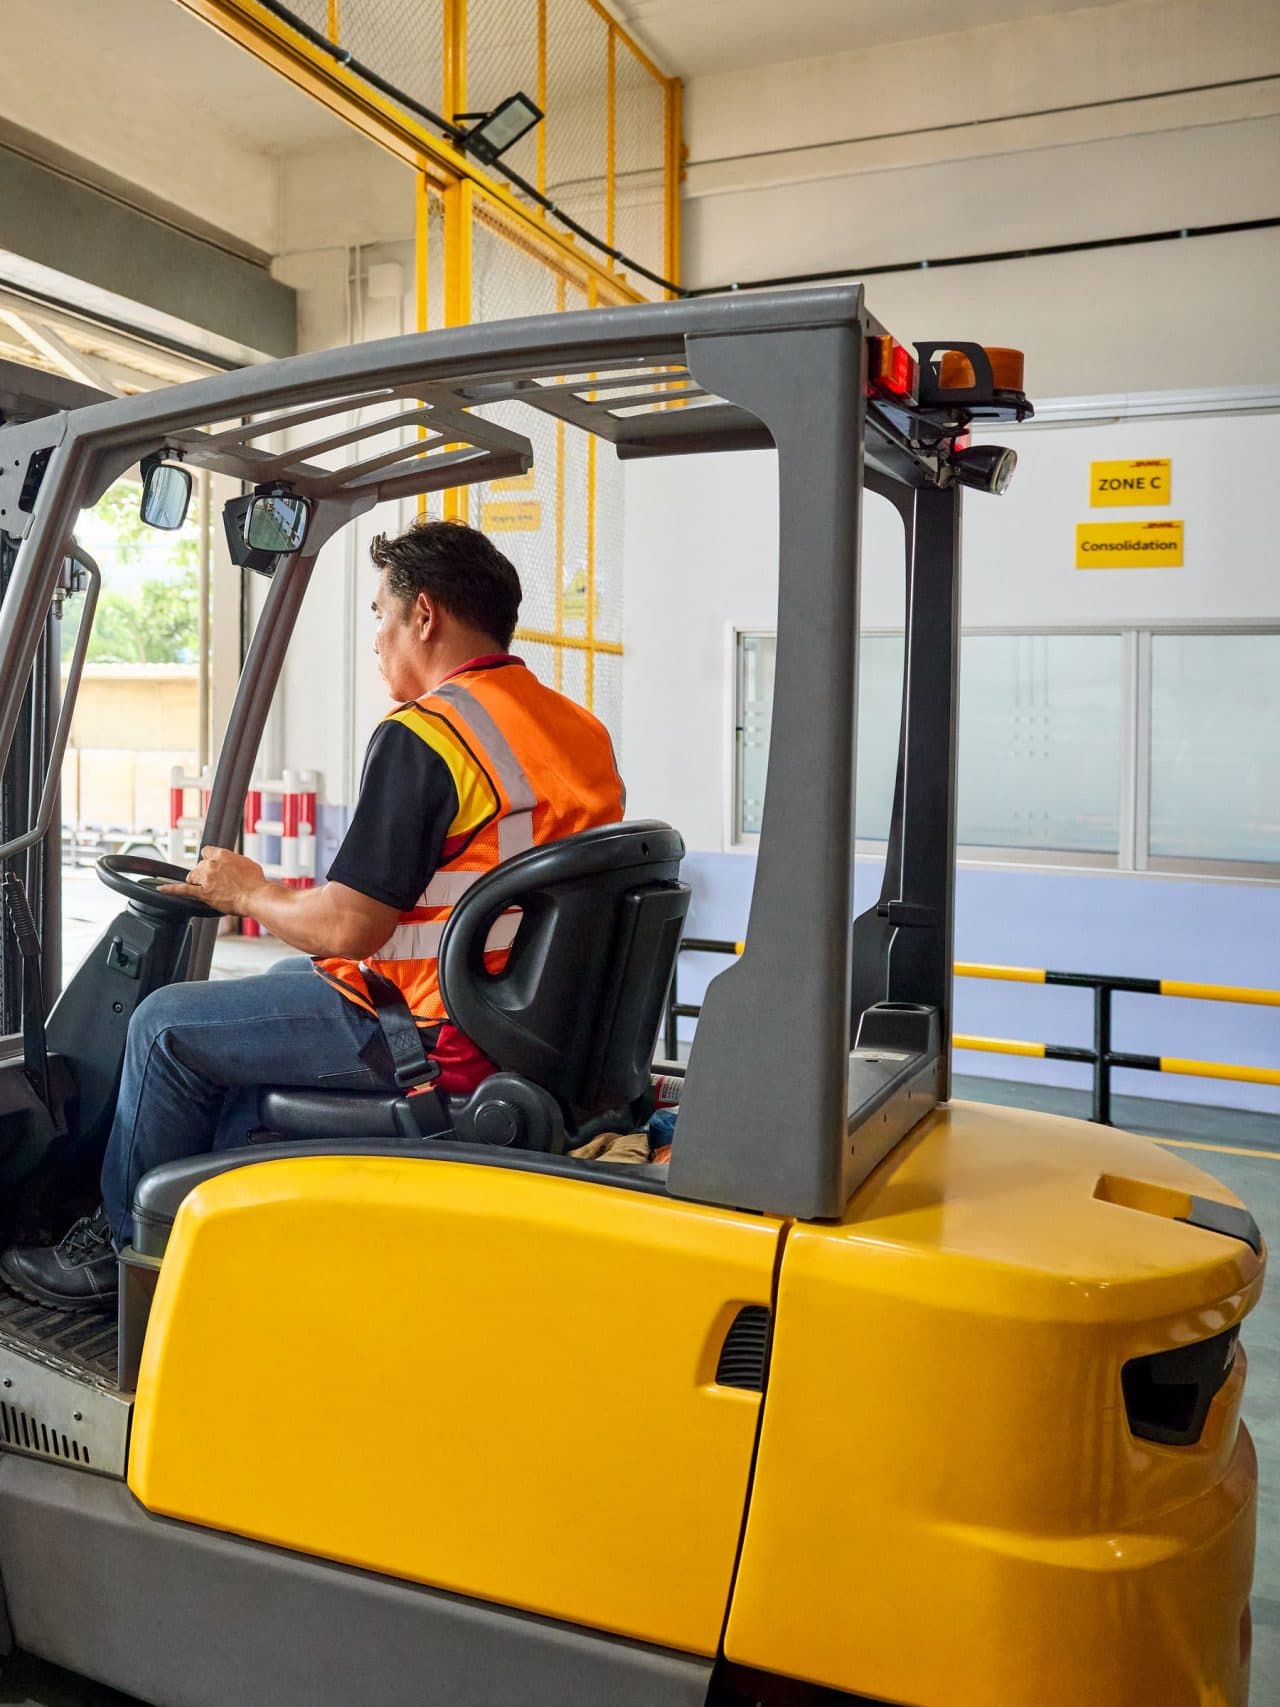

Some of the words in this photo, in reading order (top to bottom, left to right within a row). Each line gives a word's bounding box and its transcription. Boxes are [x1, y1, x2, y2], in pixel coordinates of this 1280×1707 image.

[1098, 477, 1145, 491] ZONE
[1150, 476, 1161, 489] C
[1081, 539, 1178, 552] Consolidation
